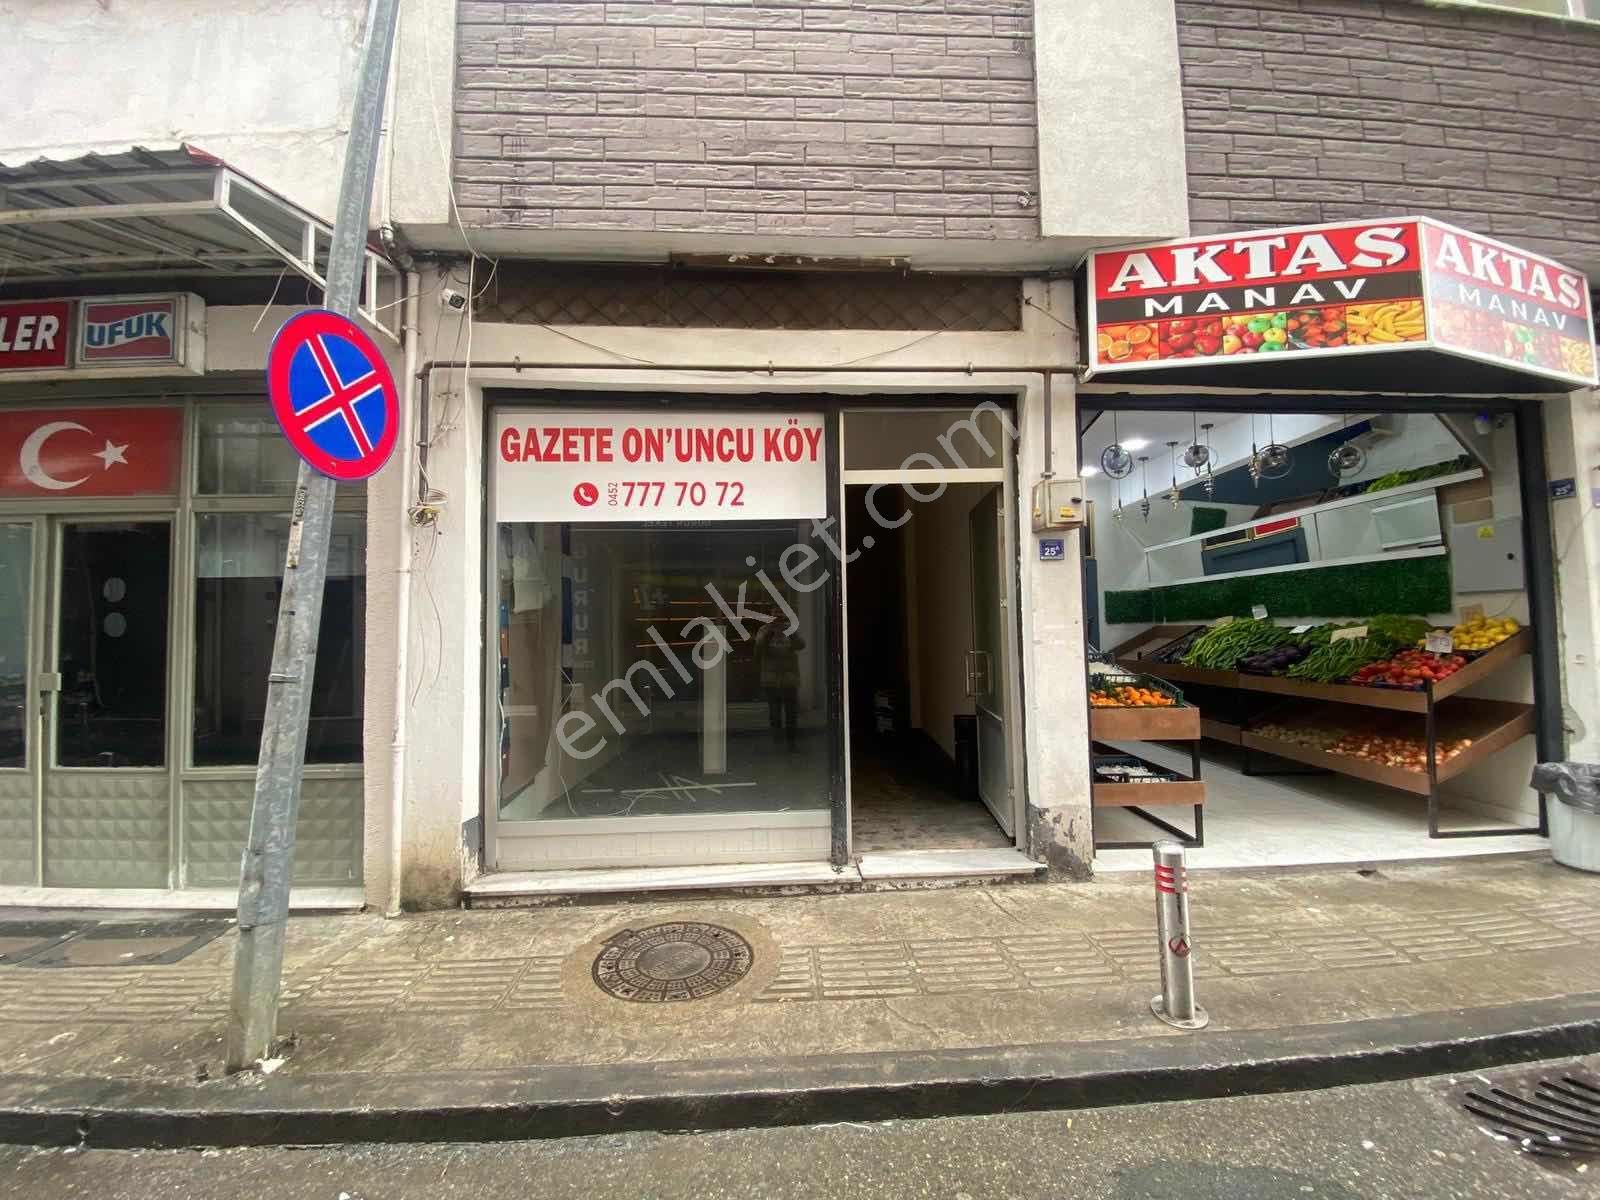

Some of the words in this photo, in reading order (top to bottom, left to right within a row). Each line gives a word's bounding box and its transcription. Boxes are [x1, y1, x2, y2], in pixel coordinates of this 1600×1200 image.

[1144, 278, 1367, 317] MANAV
[1458, 283, 1567, 330] MANAV
[86, 313, 169, 347] UFUK
[500, 427, 613, 462] GAZETE
[764, 418, 822, 463] KÖY
[607, 482, 618, 506] 0452
[622, 481, 665, 507] 777
[674, 481, 706, 507] 70
[715, 481, 745, 507] 72
